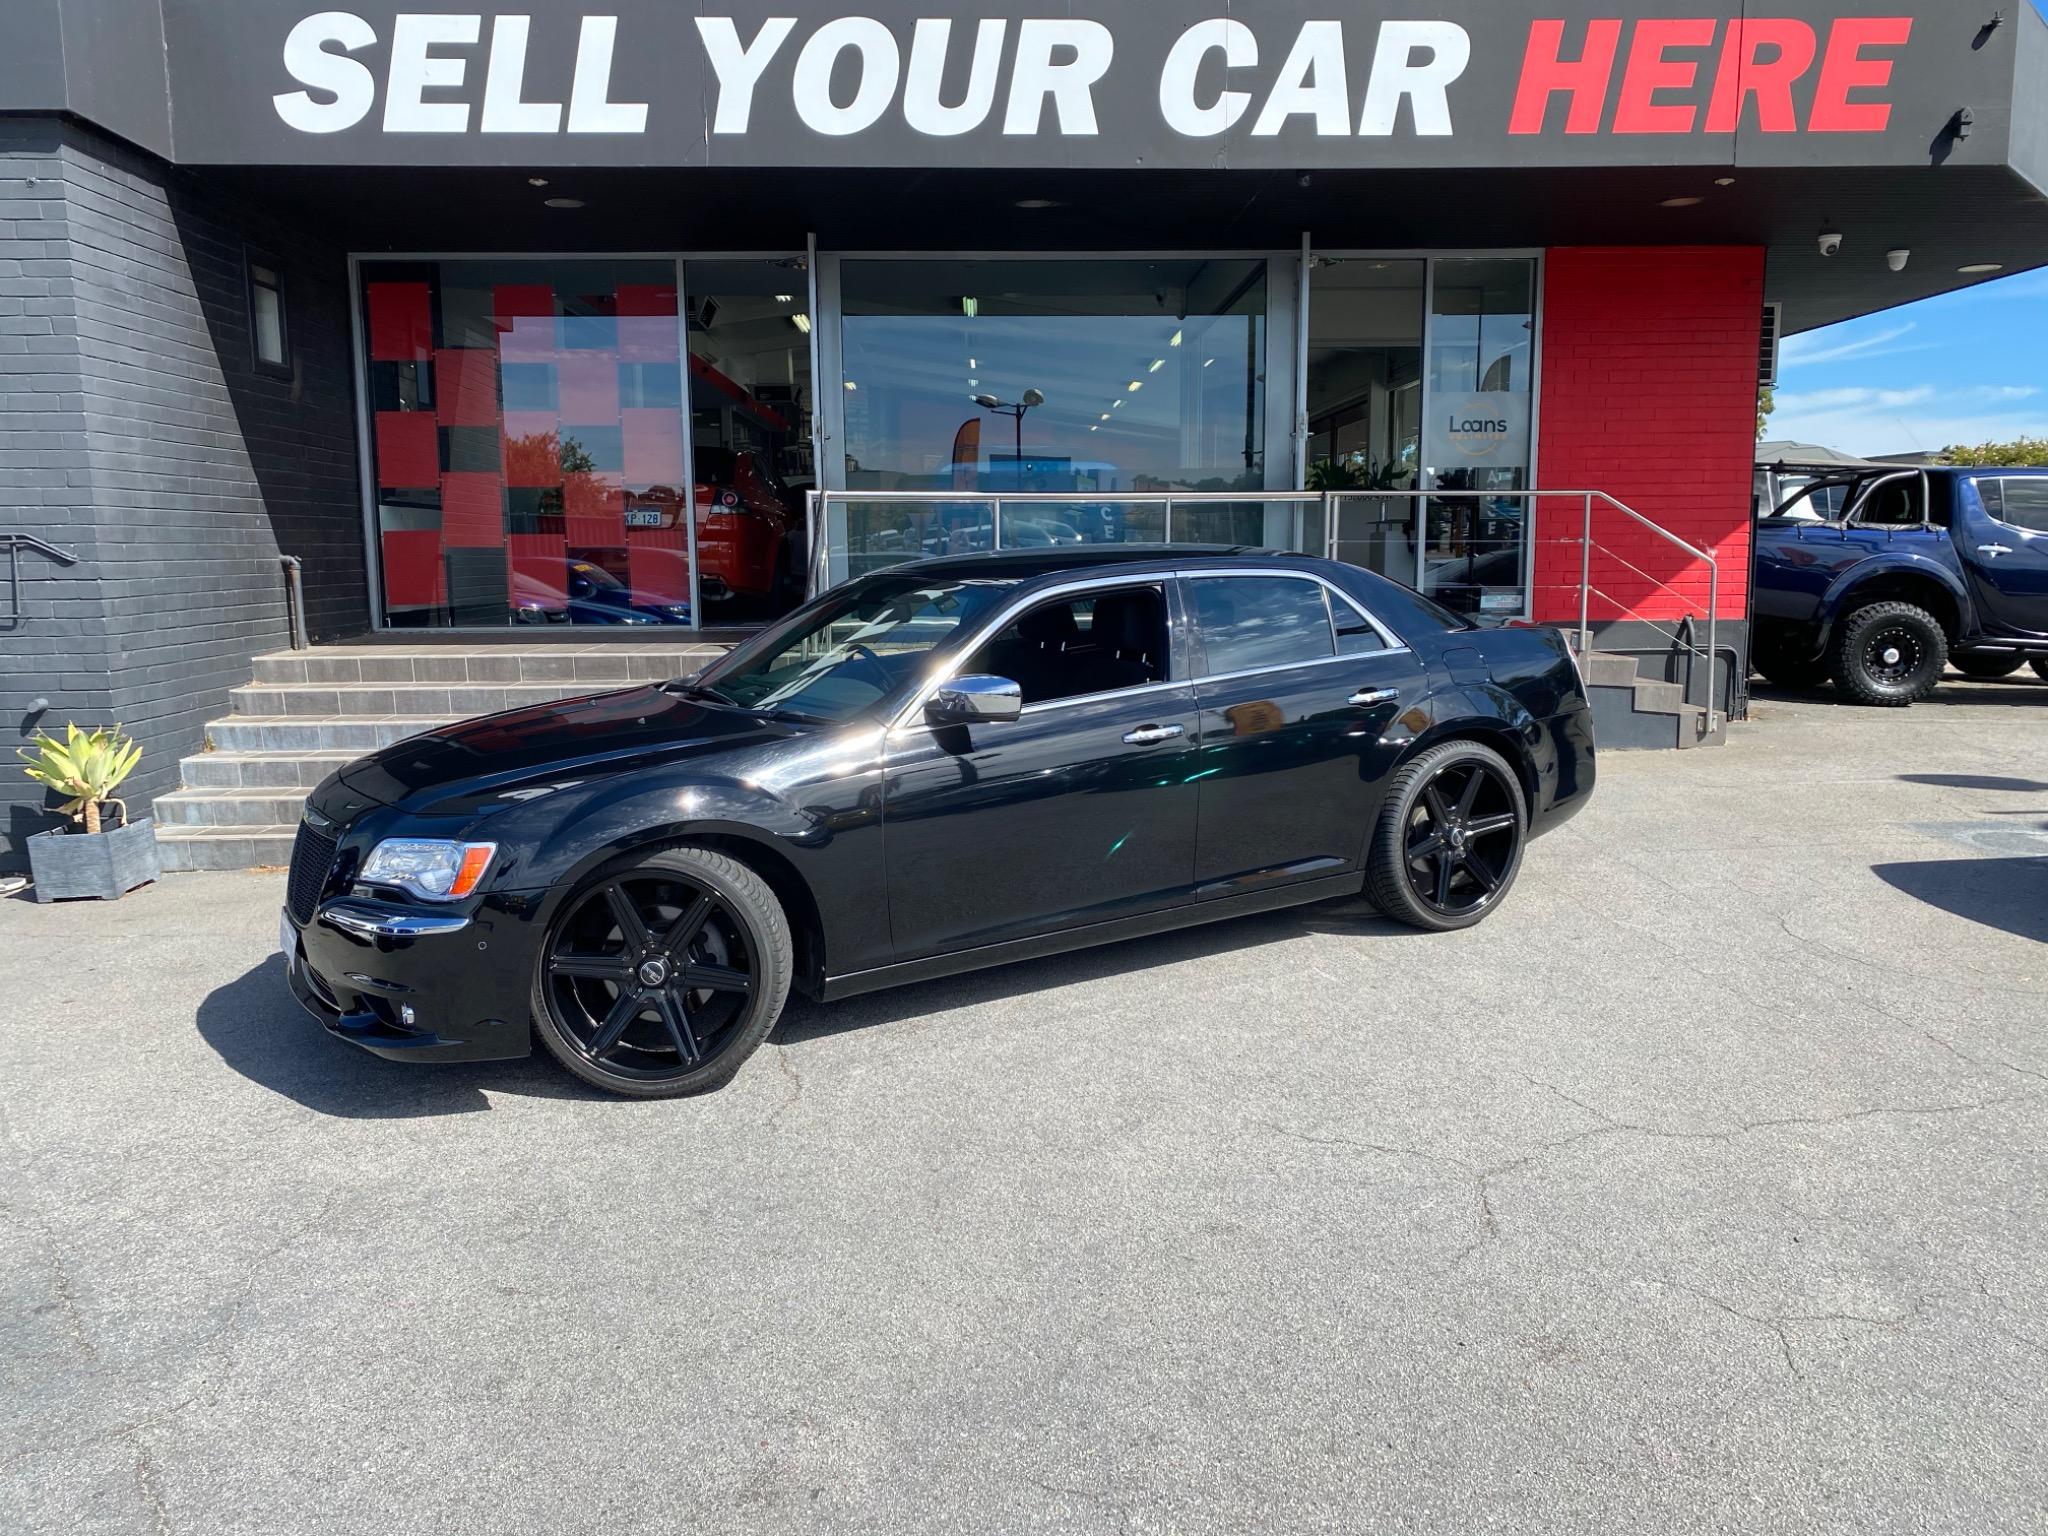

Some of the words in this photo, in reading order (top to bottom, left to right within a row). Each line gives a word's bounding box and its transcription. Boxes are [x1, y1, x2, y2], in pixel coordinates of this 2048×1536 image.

[273, 12, 649, 134] SELL
[694, 17, 1114, 137] YOUR
[1160, 18, 1471, 137] CAR
[1509, 18, 1913, 135] HERE
[1449, 415, 1507, 433] Loans
